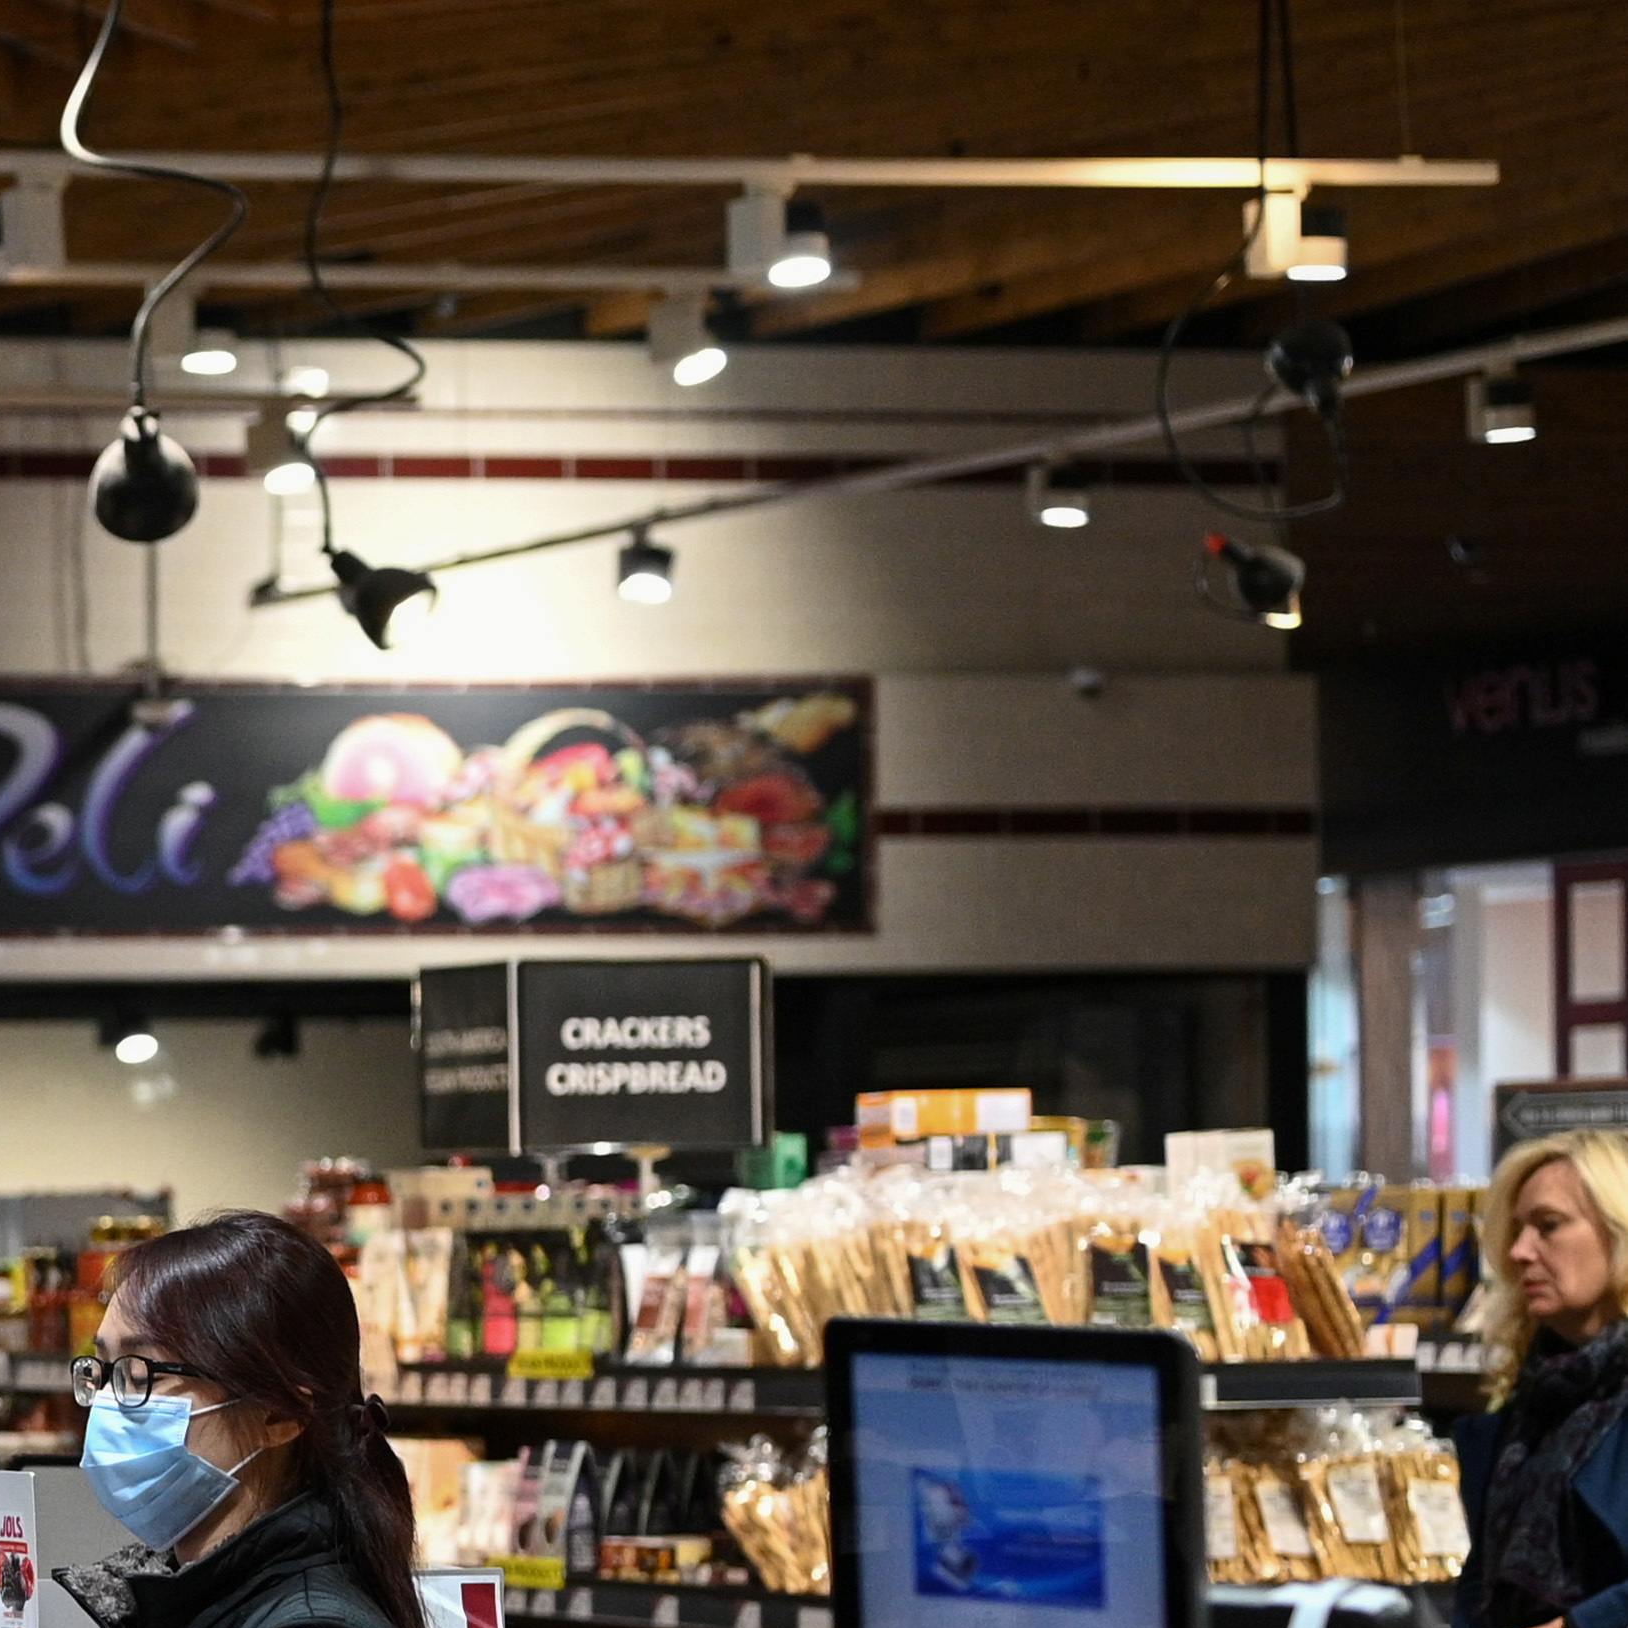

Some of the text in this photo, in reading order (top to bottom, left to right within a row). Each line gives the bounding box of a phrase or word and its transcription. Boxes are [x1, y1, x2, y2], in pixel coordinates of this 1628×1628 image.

[560, 1014, 712, 1050] CRACKERS
[545, 1060, 727, 1096] CRISPBREAD
[0, 1515, 24, 1539] JOLS
